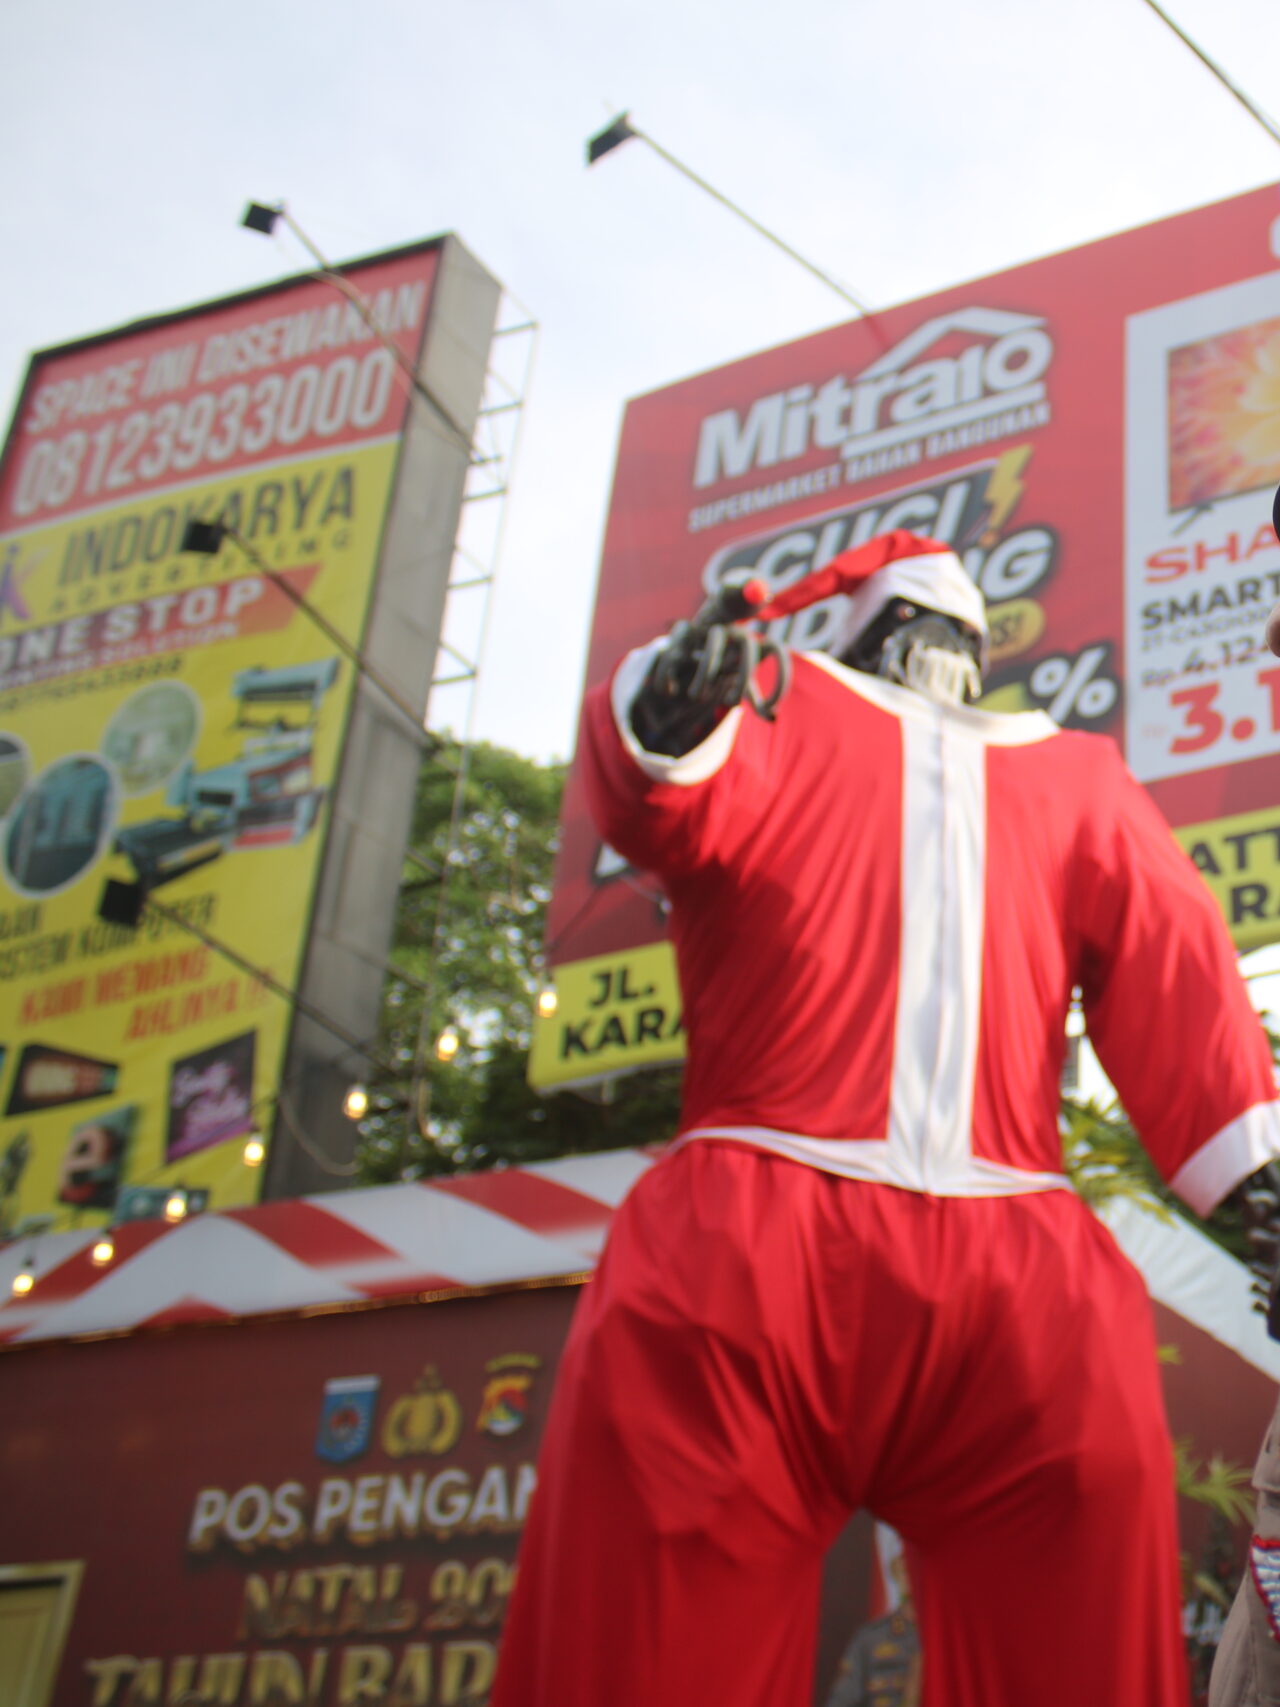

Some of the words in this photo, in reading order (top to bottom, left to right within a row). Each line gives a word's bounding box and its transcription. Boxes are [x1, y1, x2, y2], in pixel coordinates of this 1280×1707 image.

[27, 359, 143, 434] SPACE
[141, 342, 198, 397] INI
[199, 281, 426, 382] DISEWAKAN
[12, 349, 396, 517] 08123933000
[688, 464, 841, 532] SUPERMARKET
[846, 441, 922, 483] BAHAN
[925, 401, 1051, 457] BANGUNAN
[104, 577, 265, 643] STOP
[1182, 636, 1268, 675] 4.12
[589, 968, 657, 1008] JL.
[188, 1482, 304, 1544] POS
[313, 1463, 538, 1535] PENGAN
[428, 1559, 518, 1632] 20
[337, 1640, 497, 1706] BAR
